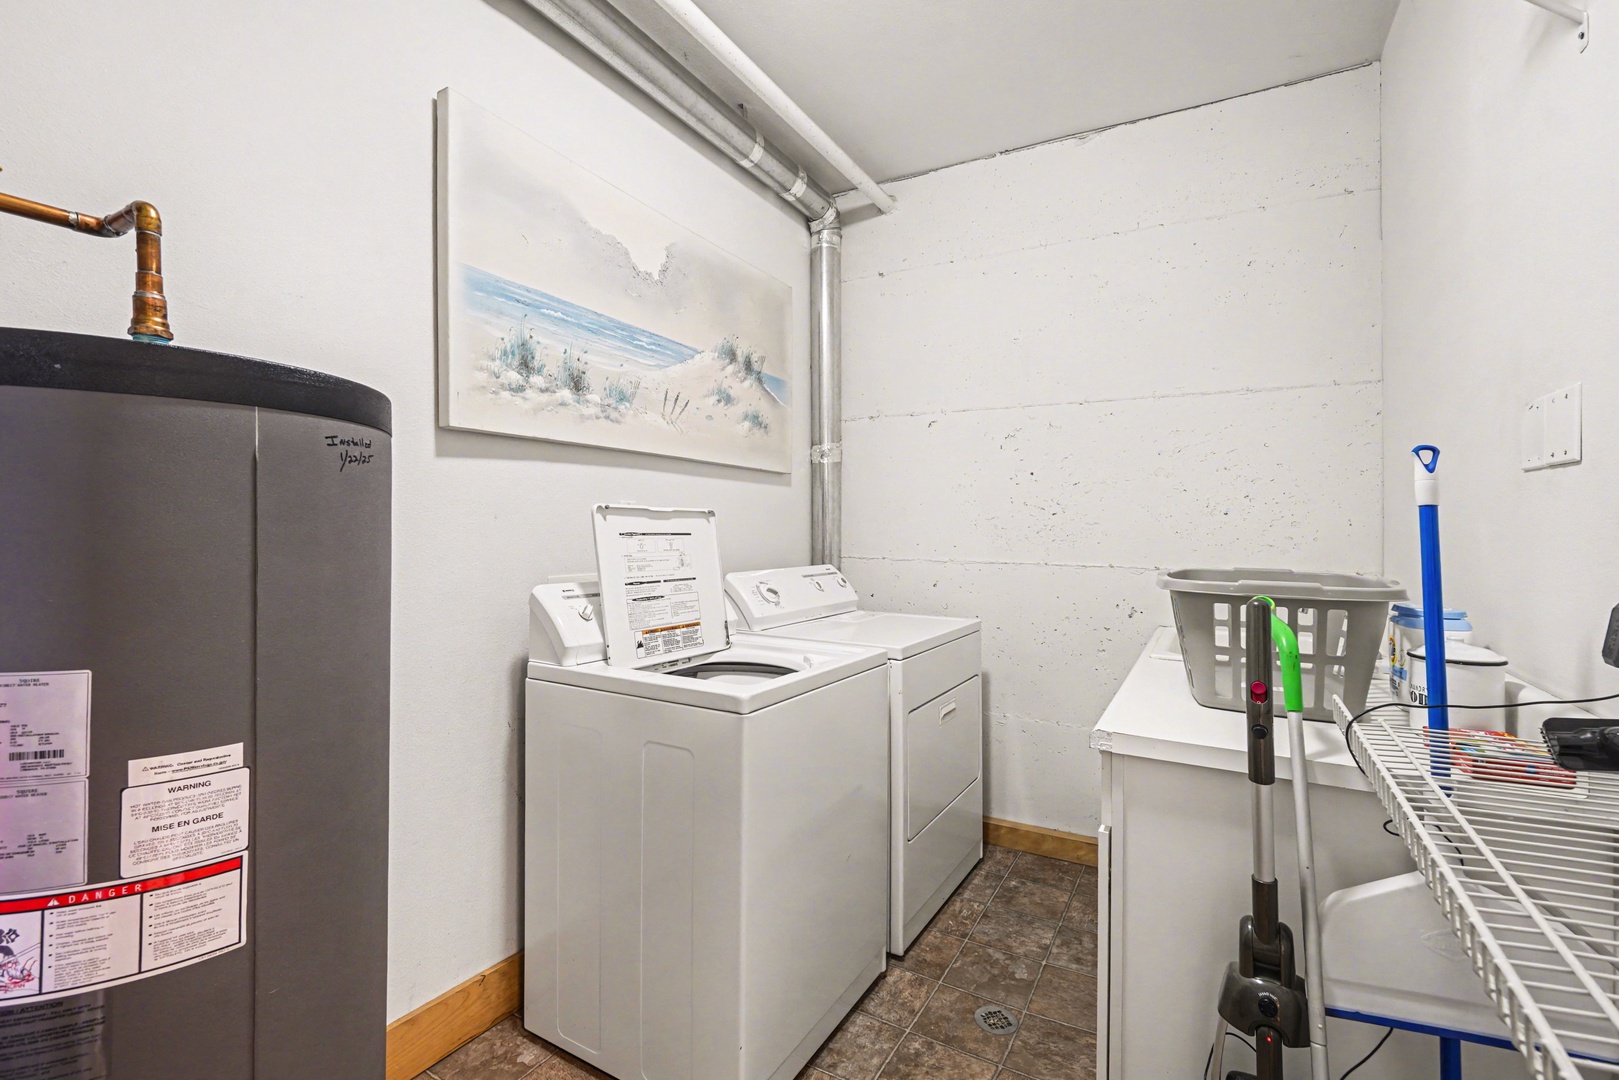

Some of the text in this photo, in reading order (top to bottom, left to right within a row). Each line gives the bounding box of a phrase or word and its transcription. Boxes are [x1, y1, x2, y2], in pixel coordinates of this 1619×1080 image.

[340, 450, 374, 472] 1/22/25
[168, 780, 212, 794] WARNING
[152, 812, 224, 832] MISE EN GARDE
[68, 884, 142, 904] DANGER
